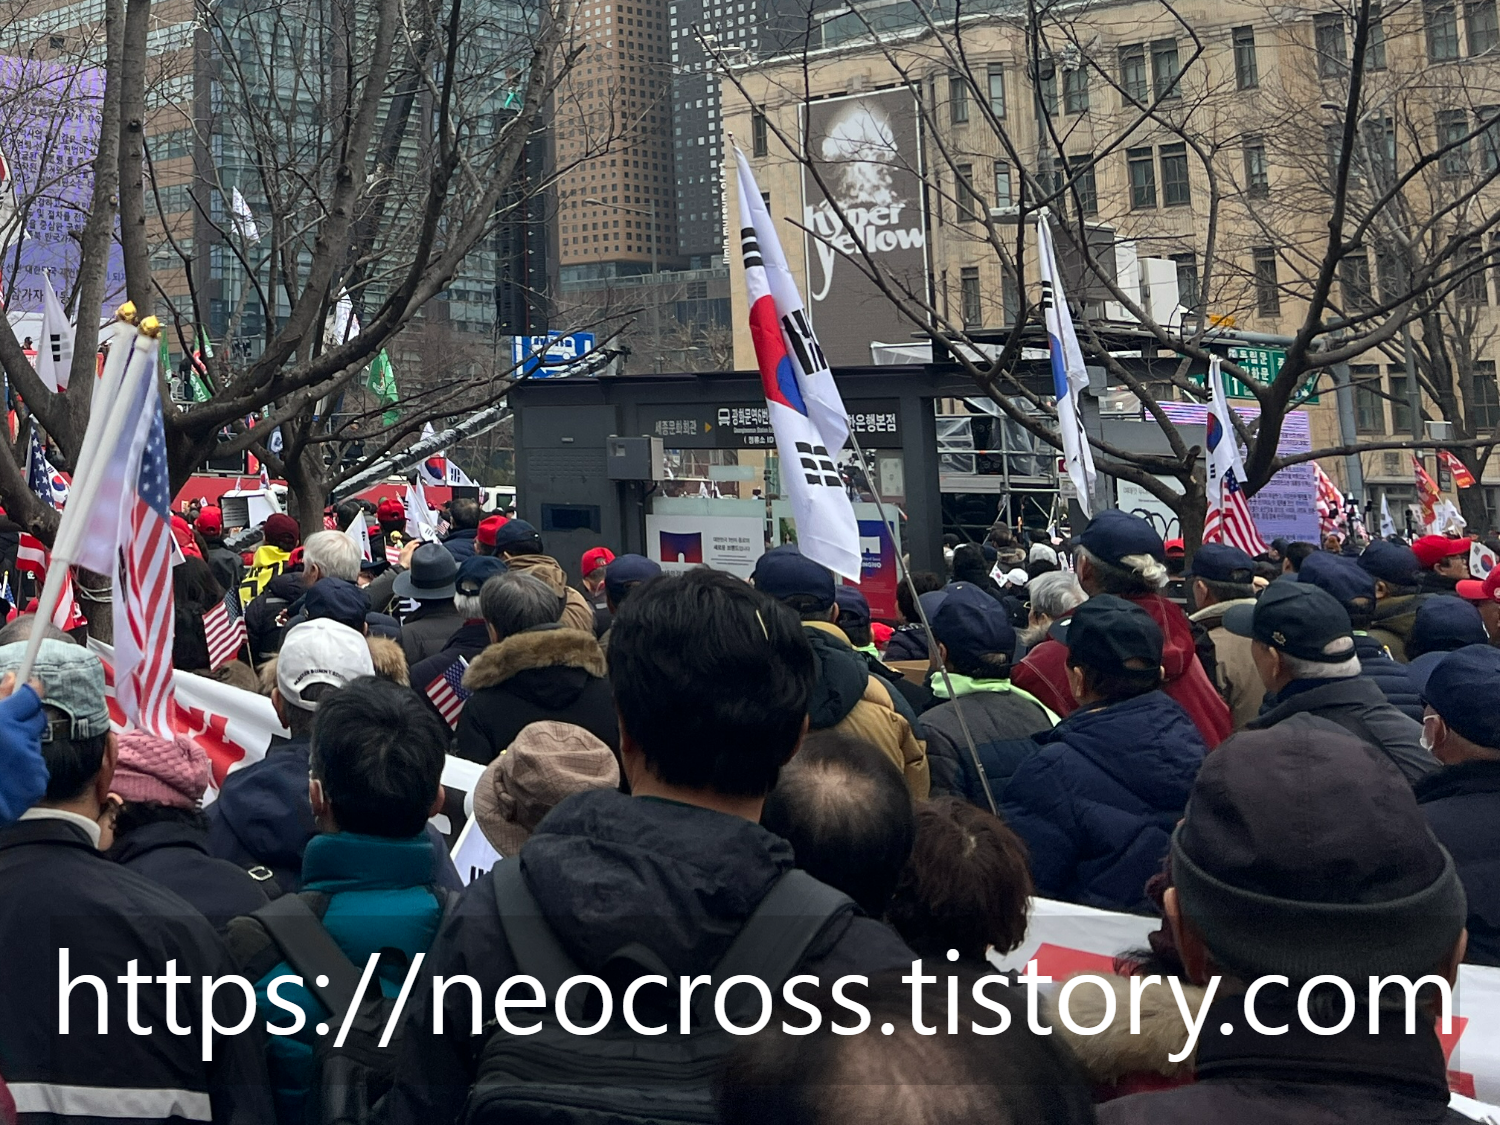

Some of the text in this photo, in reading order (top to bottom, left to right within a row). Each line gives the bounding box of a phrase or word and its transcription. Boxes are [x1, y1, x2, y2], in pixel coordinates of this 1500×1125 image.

[804, 201, 906, 238] hyper
[811, 224, 925, 302] yellow
[655, 419, 697, 436] 세종문화회관
[731, 407, 770, 426] 광화문역6번
